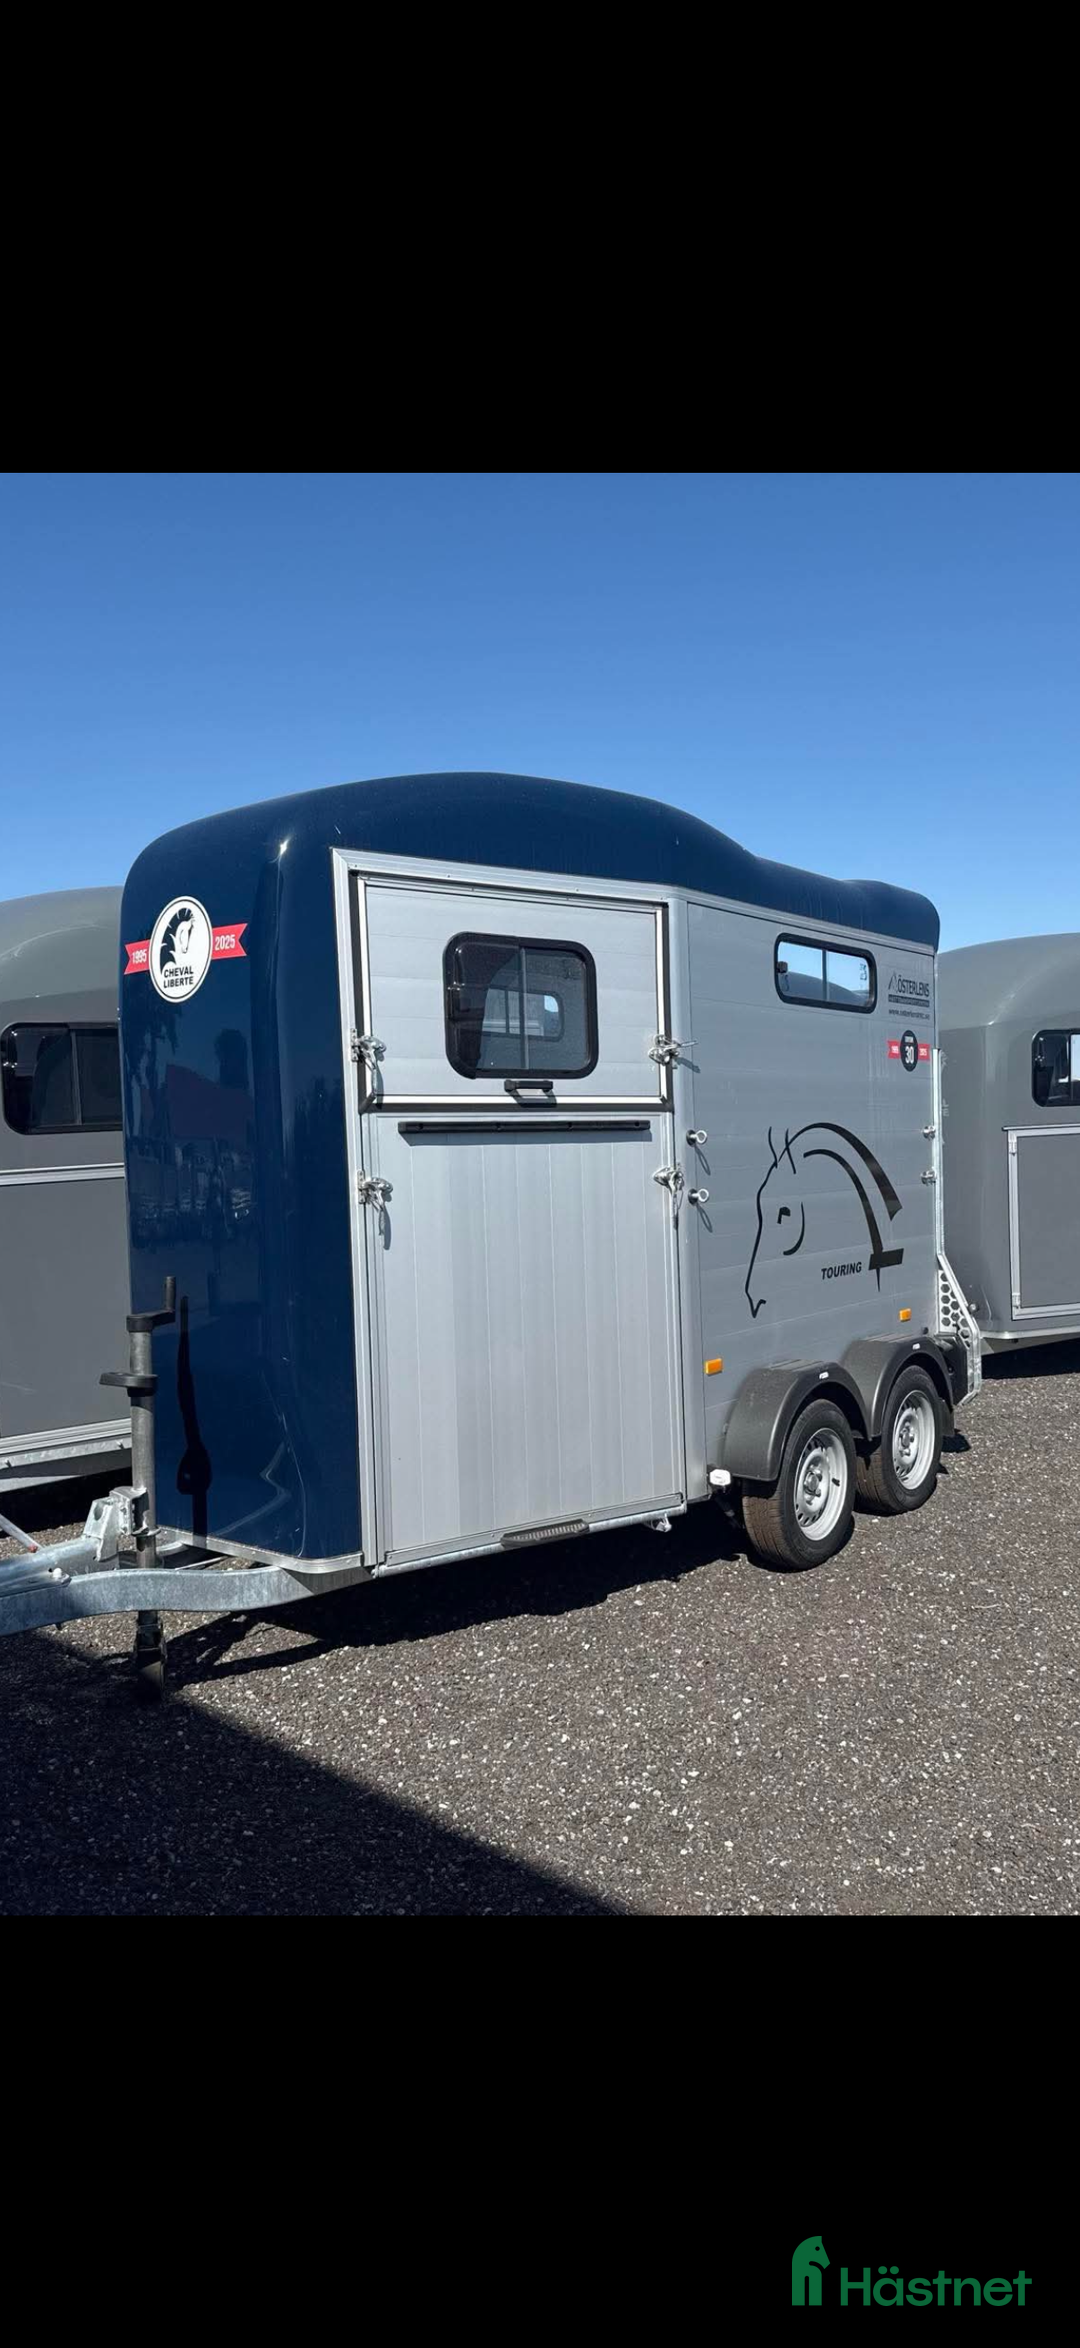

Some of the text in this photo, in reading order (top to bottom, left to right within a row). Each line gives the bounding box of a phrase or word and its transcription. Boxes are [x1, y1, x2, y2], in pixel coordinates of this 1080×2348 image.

[215, 934, 236, 951] 2025
[132, 948, 148, 964] 1995
[163, 965, 194, 978] CHEVAL
[163, 976, 194, 989] LIBERTE
[897, 974, 930, 997] ÖSTERLENS
[905, 1045, 915, 1064] 30
[821, 1261, 862, 1280] TOURING
